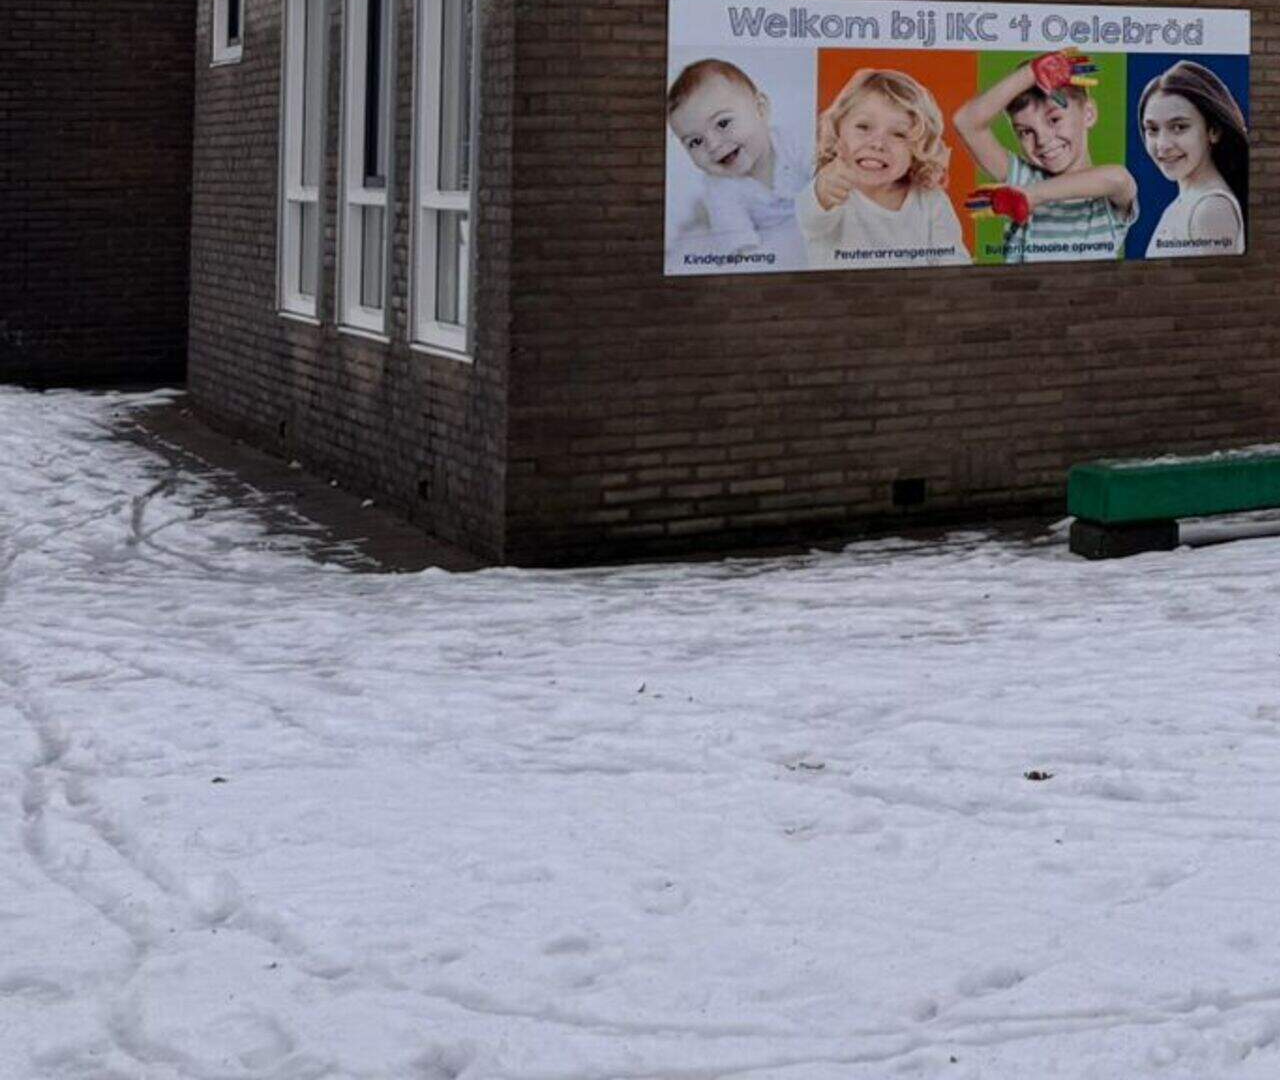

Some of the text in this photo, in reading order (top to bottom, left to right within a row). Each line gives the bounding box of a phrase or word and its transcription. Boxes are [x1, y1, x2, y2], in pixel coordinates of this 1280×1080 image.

[727, 6, 880, 39] Welkom
[890, 10, 937, 47] bij
[946, 12, 999, 42] IKC
[1041, 14, 1204, 46] Oelebröd
[684, 252, 776, 266] Kinderopvang
[833, 245, 956, 261] Peuterarrangement
